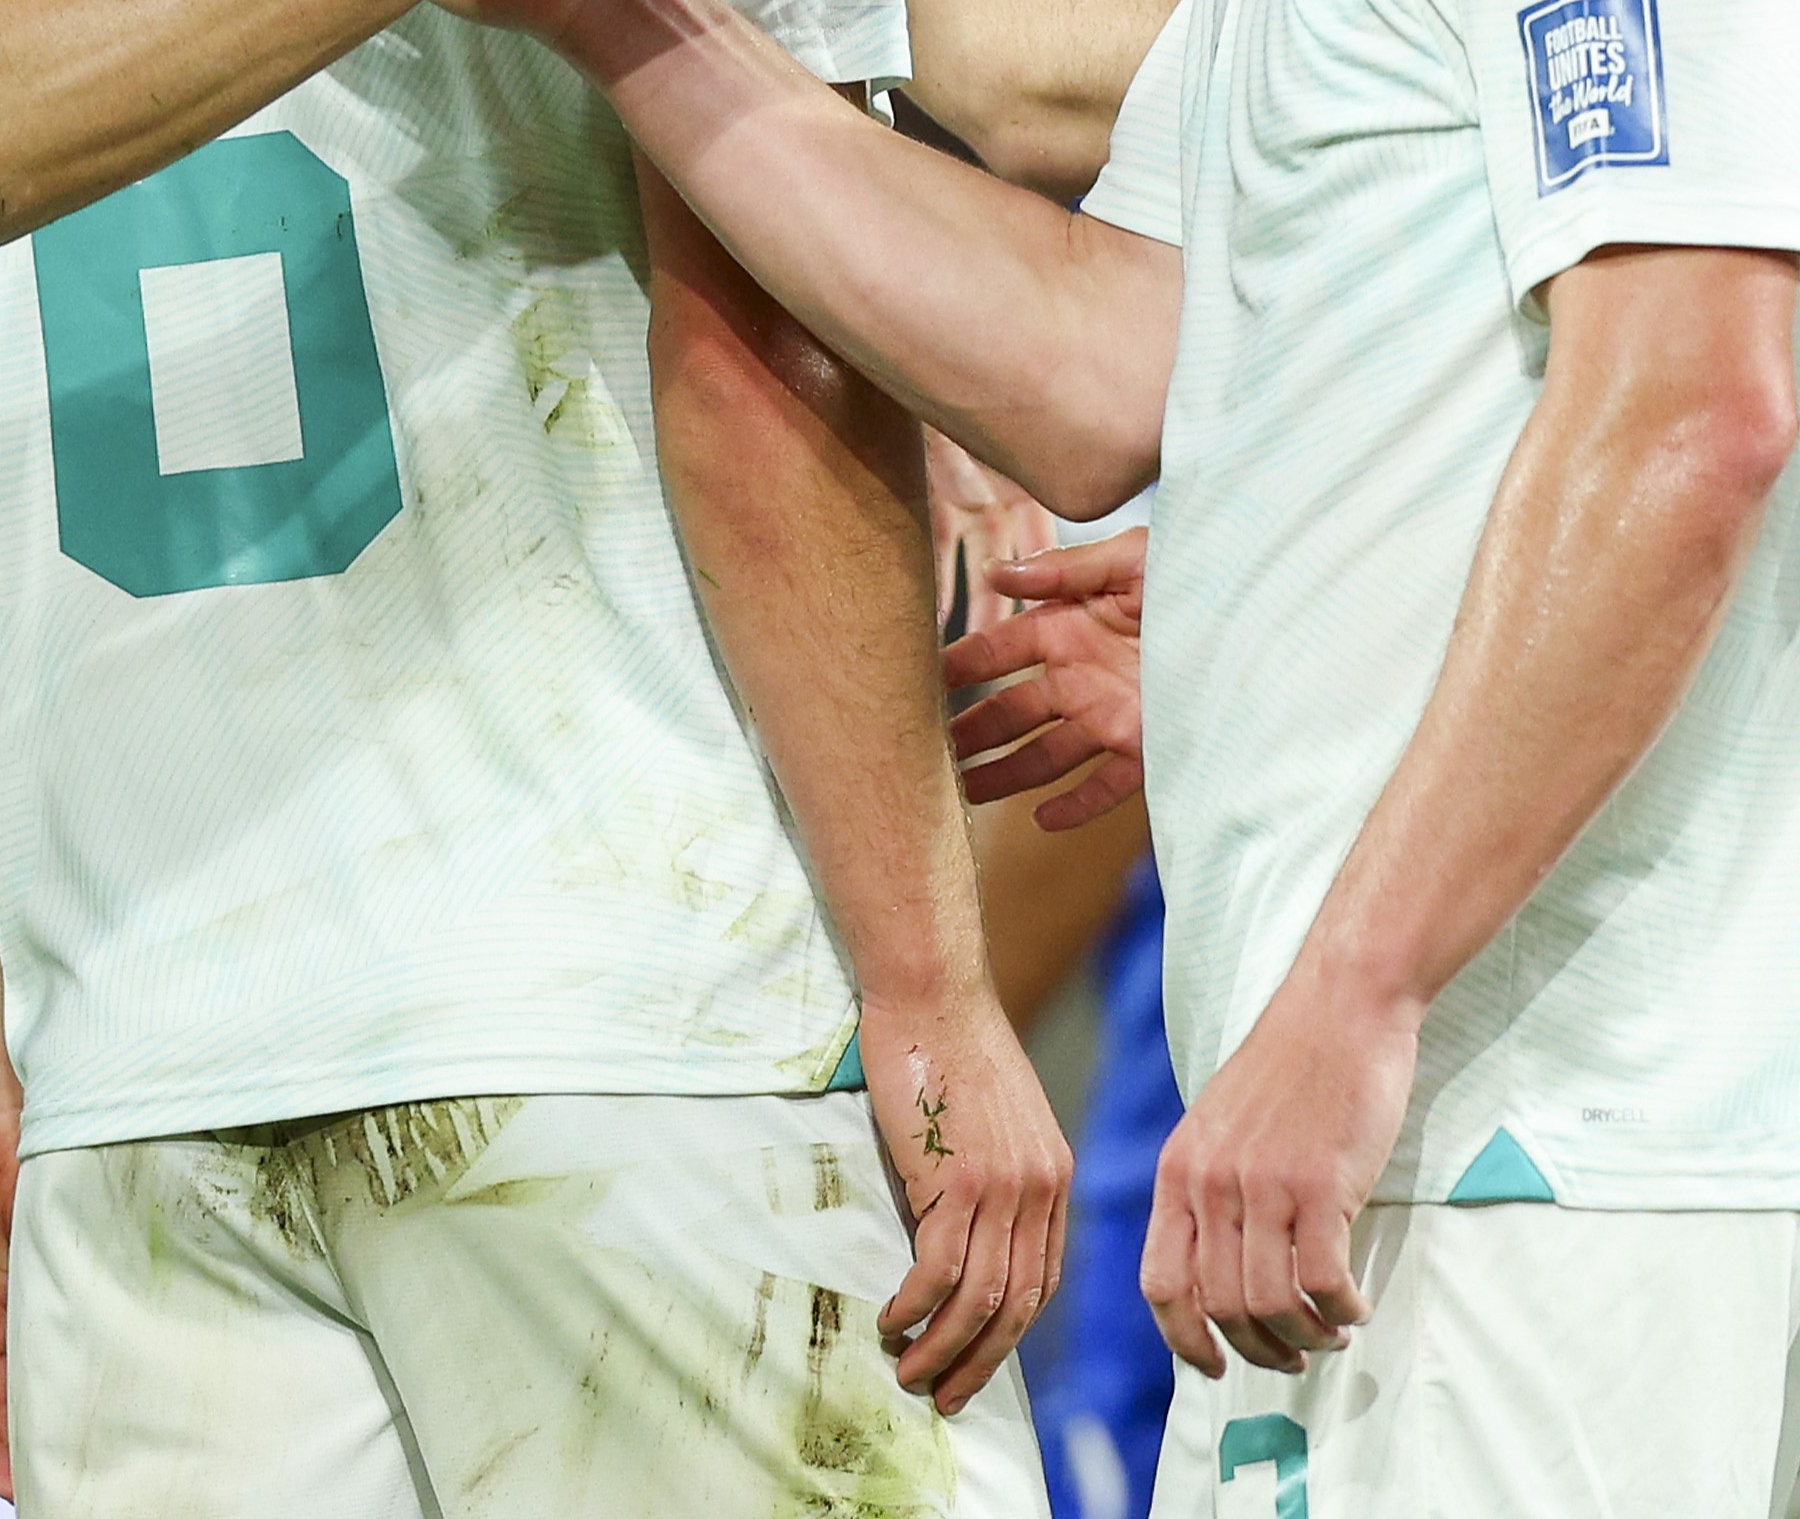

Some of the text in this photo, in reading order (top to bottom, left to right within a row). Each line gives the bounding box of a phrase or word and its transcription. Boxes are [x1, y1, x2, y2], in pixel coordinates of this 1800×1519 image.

[1545, 16, 1623, 57] FOOTBALL
[1548, 42, 1625, 91] UNITES
[1549, 75, 1633, 125] the World
